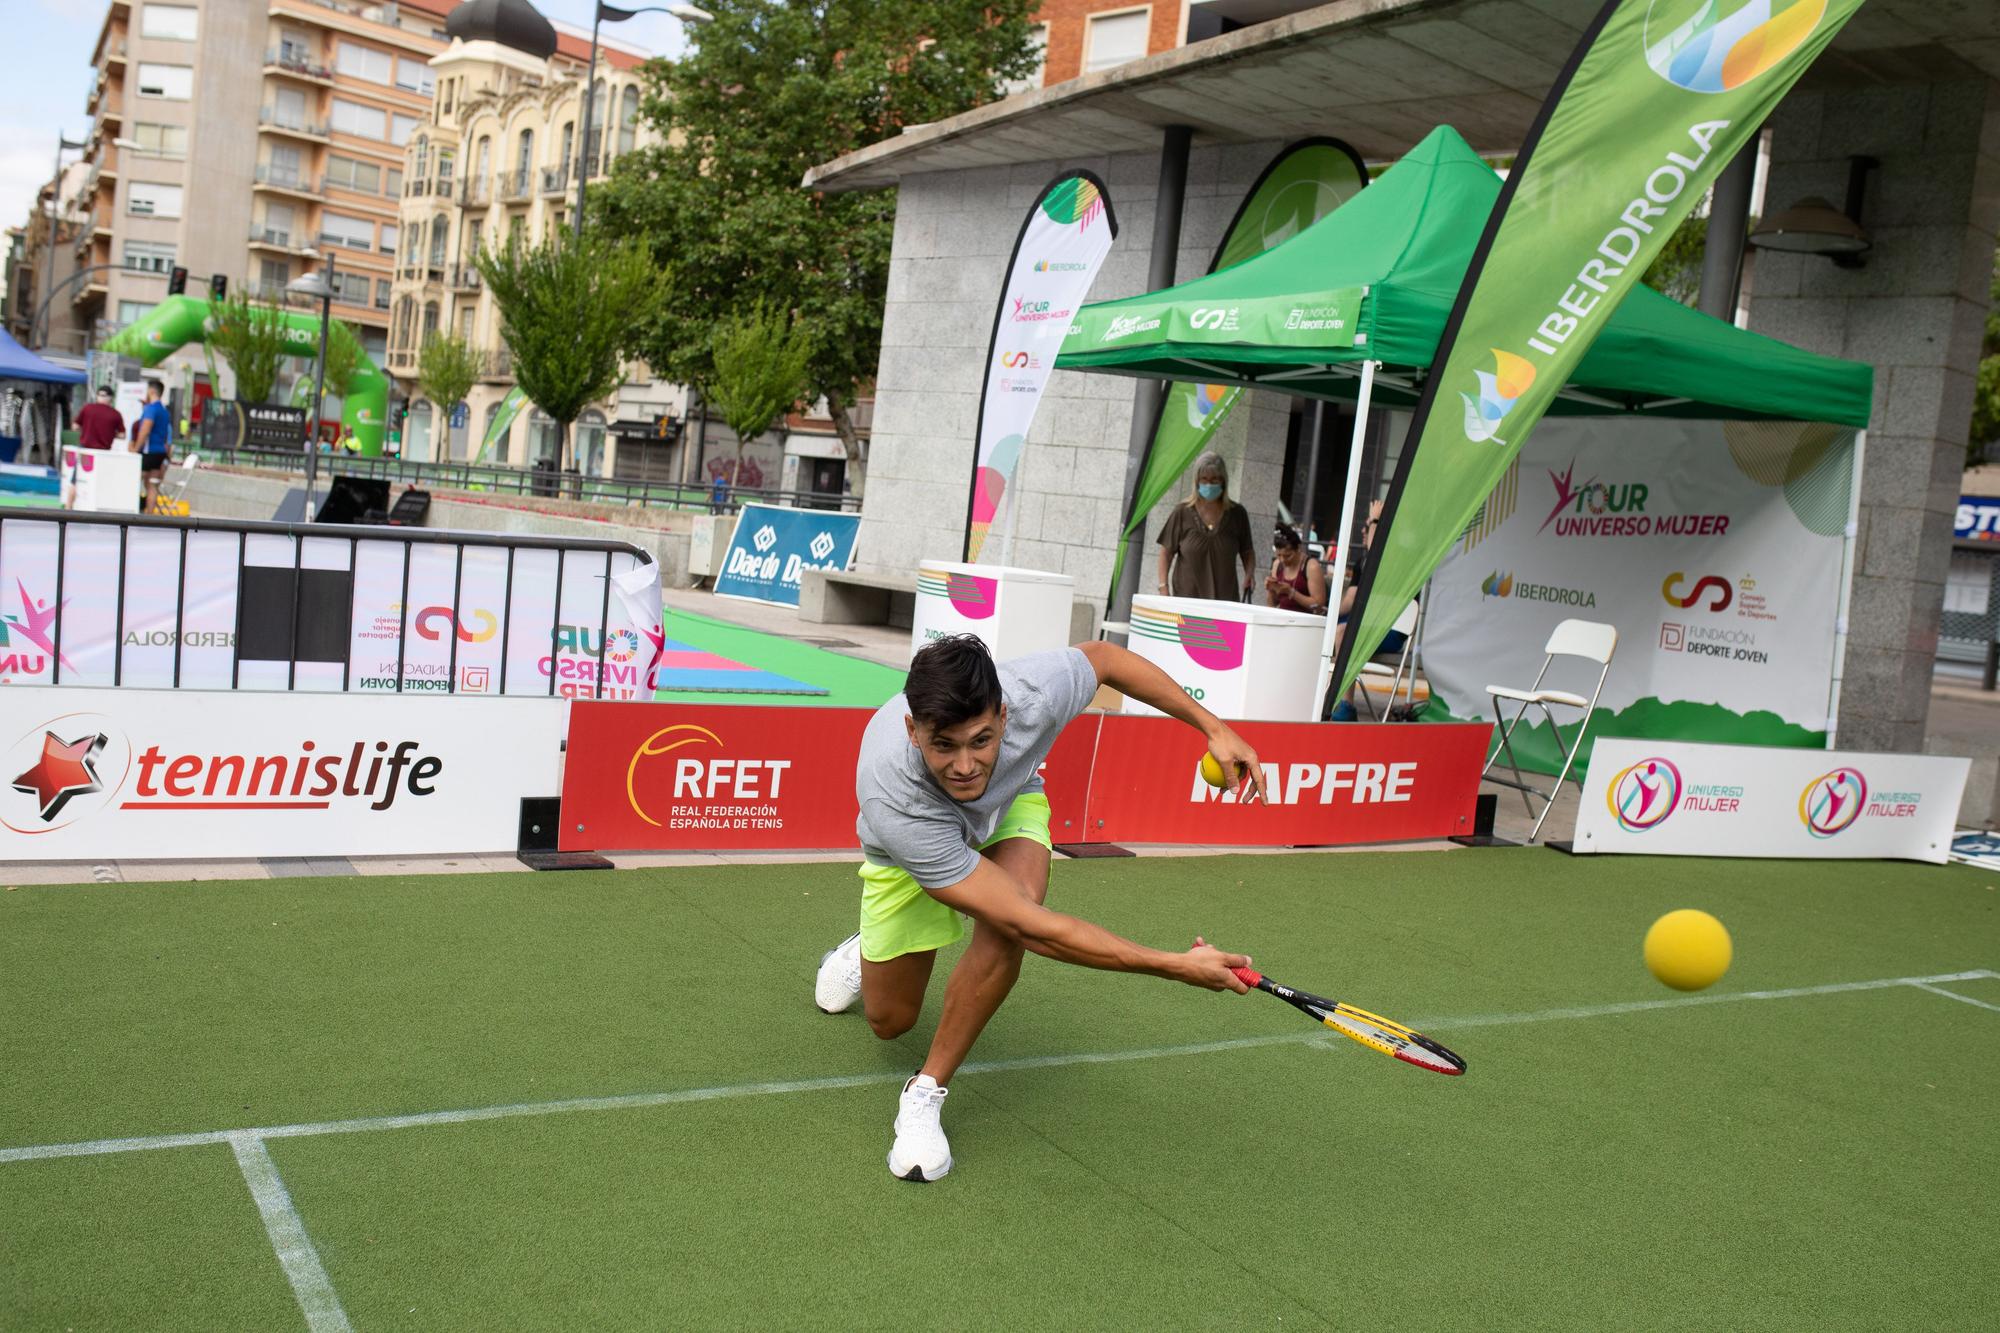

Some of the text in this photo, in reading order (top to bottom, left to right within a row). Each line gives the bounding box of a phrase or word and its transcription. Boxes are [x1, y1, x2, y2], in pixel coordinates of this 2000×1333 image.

[1527, 119, 1732, 355] IBERDROLA
[1573, 484, 1649, 515] TOUR
[1556, 515, 1730, 537] UNIVERSO MUJER
[1515, 582, 1596, 609] IBERDROLA
[1747, 610, 1777, 621] Deportes
[1689, 625, 1756, 646] FUNDACIÓN
[1687, 641, 1769, 665] DEPORTE JOVEN
[137, 741, 443, 811] tennislife
[673, 758, 791, 799] RFET
[1687, 784, 1745, 798] UNIVERSO
[671, 804, 777, 817] REAL FEDERACIÓN
[1683, 796, 1740, 812] MUJER
[1866, 803, 1917, 817] MUJER
[670, 816, 783, 829] ESPAÑOLA DE TENIS
[1277, 986, 1295, 998] RFET
